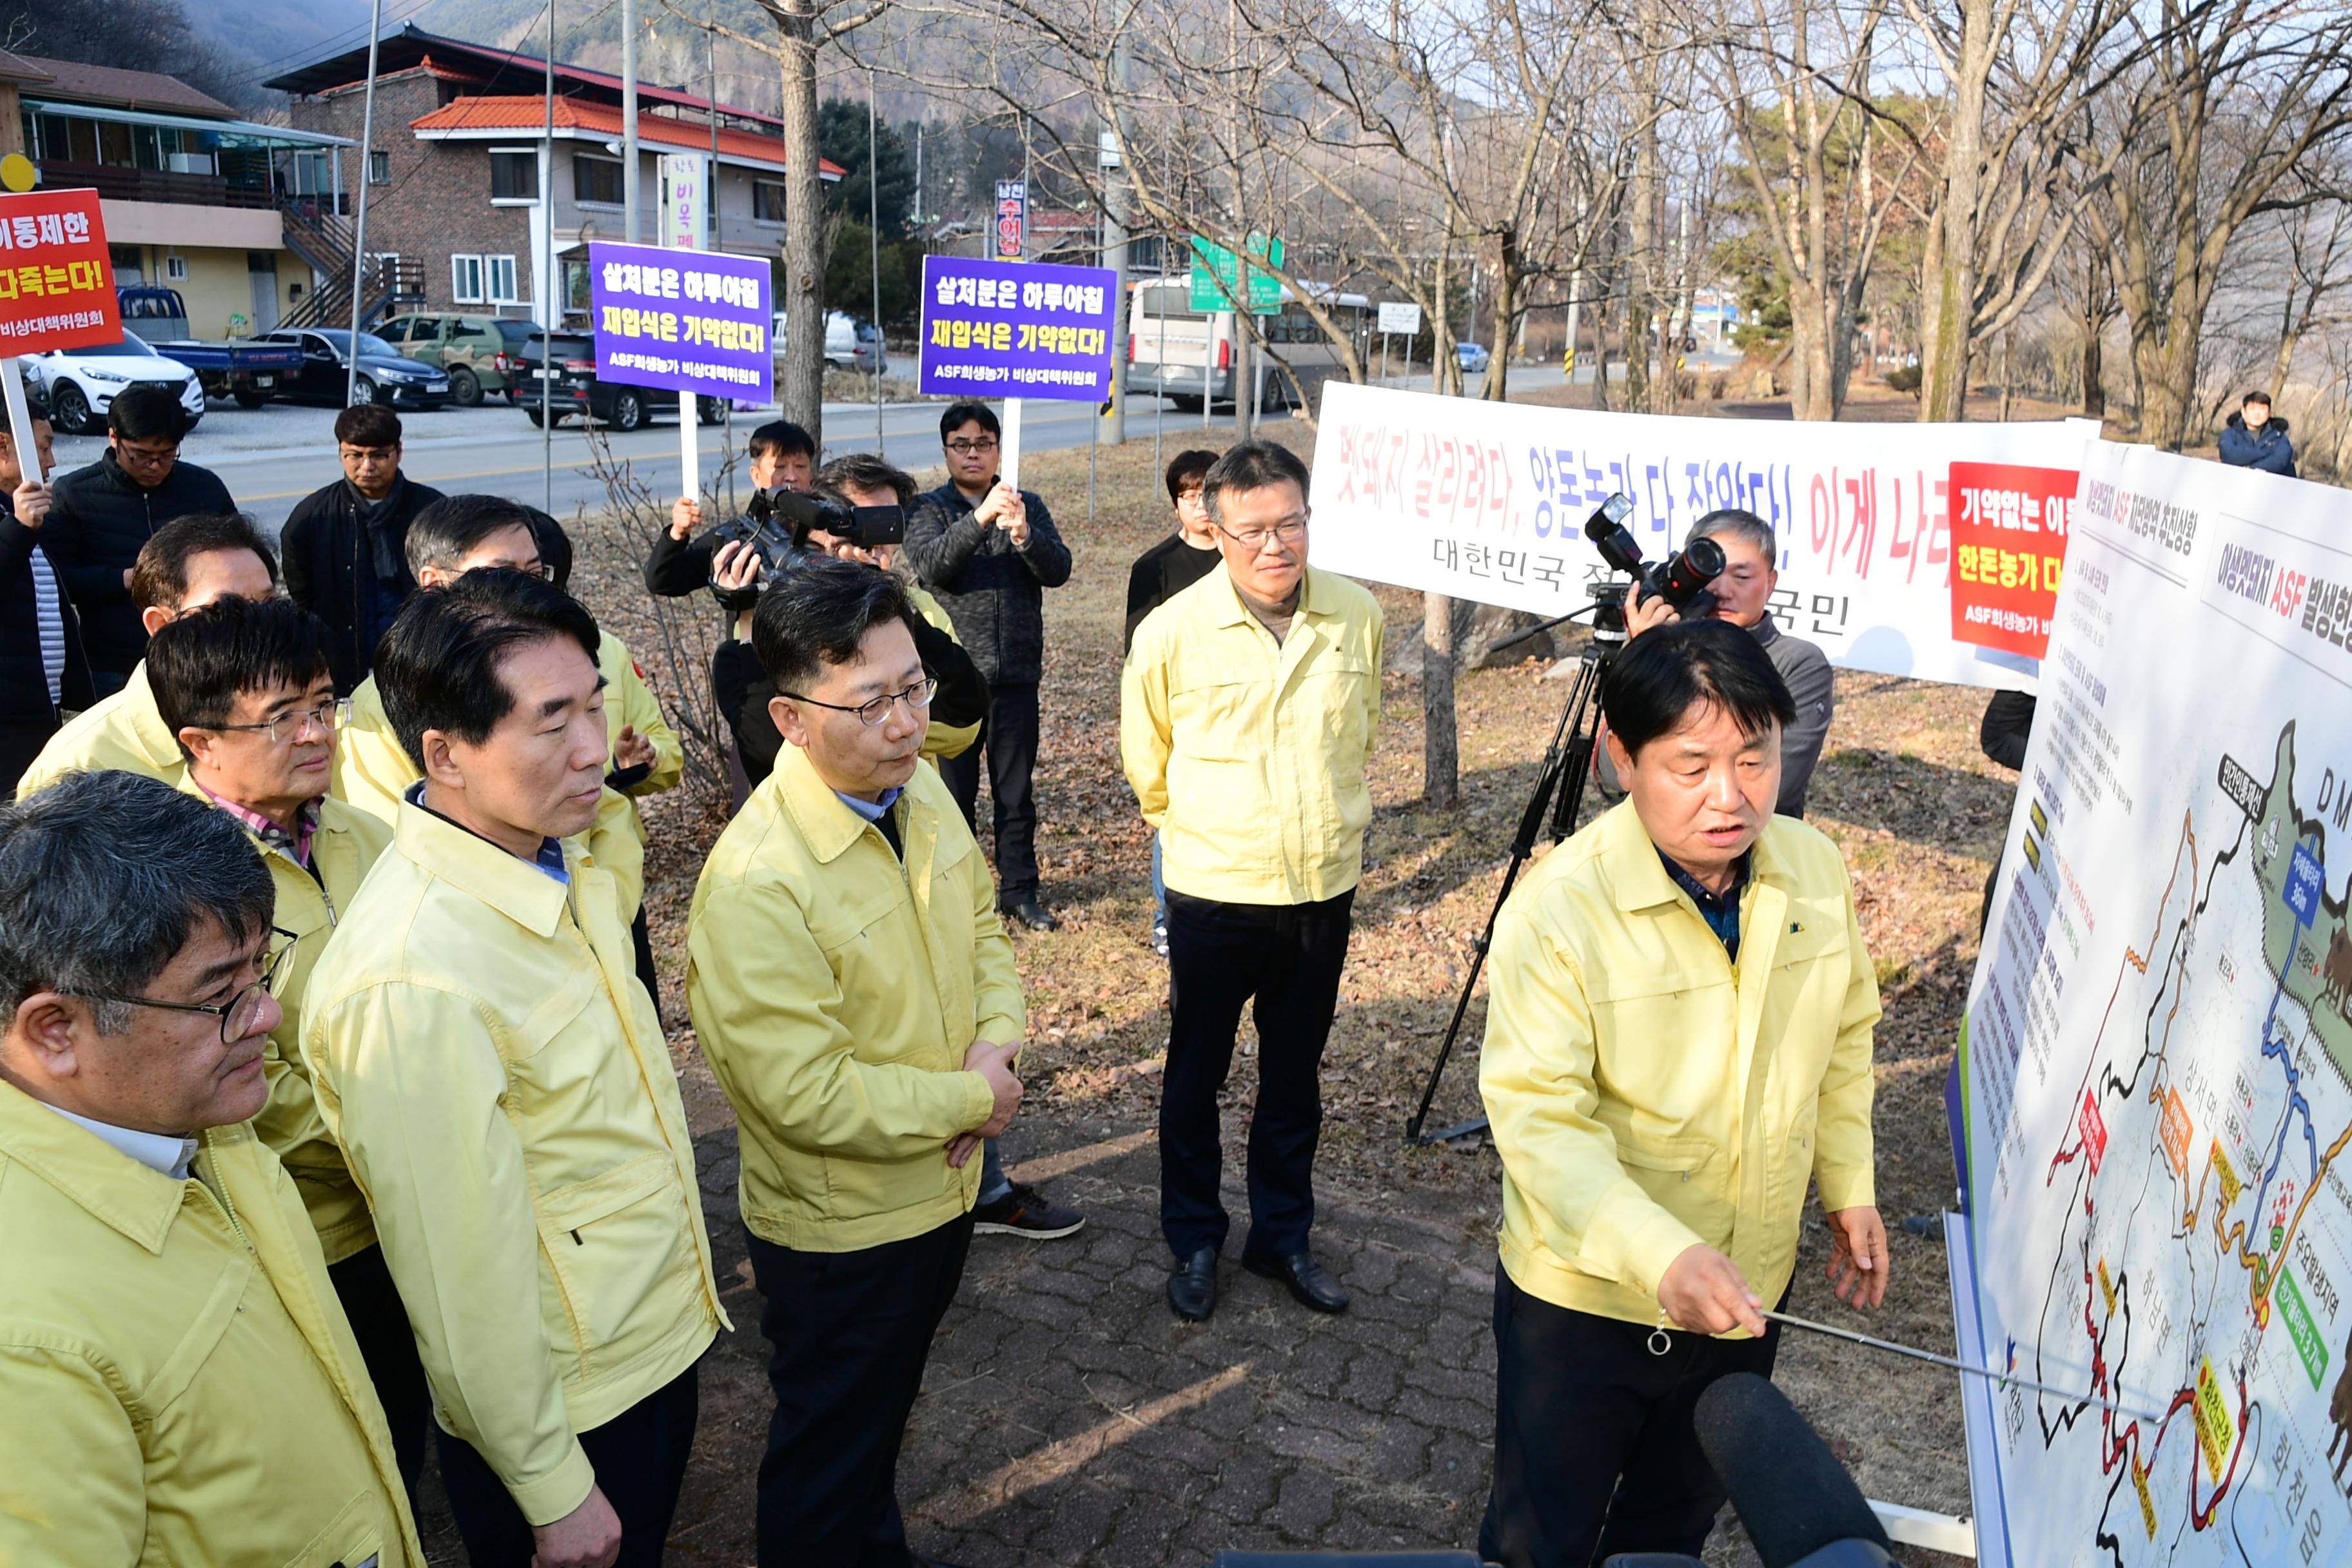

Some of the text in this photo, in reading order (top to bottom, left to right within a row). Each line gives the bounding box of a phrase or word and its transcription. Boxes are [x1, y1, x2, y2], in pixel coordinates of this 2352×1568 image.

[0, 260, 104, 300] 다죽는다!
[602, 262, 760, 309] 살처분은 하루아침
[936, 275, 1104, 315] 살처분은 하루아침
[602, 306, 765, 353] 재입식은 기약없다!
[930, 319, 1106, 356] 재입식은 기약없다!
[609, 351, 760, 387] ASF희생농가 비상대책위원회
[934, 364, 1097, 387] ASF희생농가 비상대책위원회
[1810, 466, 1877, 580] 이게
[1960, 487, 2040, 533] 기약없는
[1433, 538, 1565, 593] 대한민국
[1957, 544, 2039, 592] 한돈농가
[2217, 542, 2275, 606] 야생멧돼지
[2269, 567, 2307, 620] ASF
[1965, 604, 2038, 636] ASF희생농가
[2222, 759, 2263, 819] 민간인통제선
[2295, 1228, 2340, 1326] 주요발생지역
[2204, 1378, 2232, 1456] 화천군청
